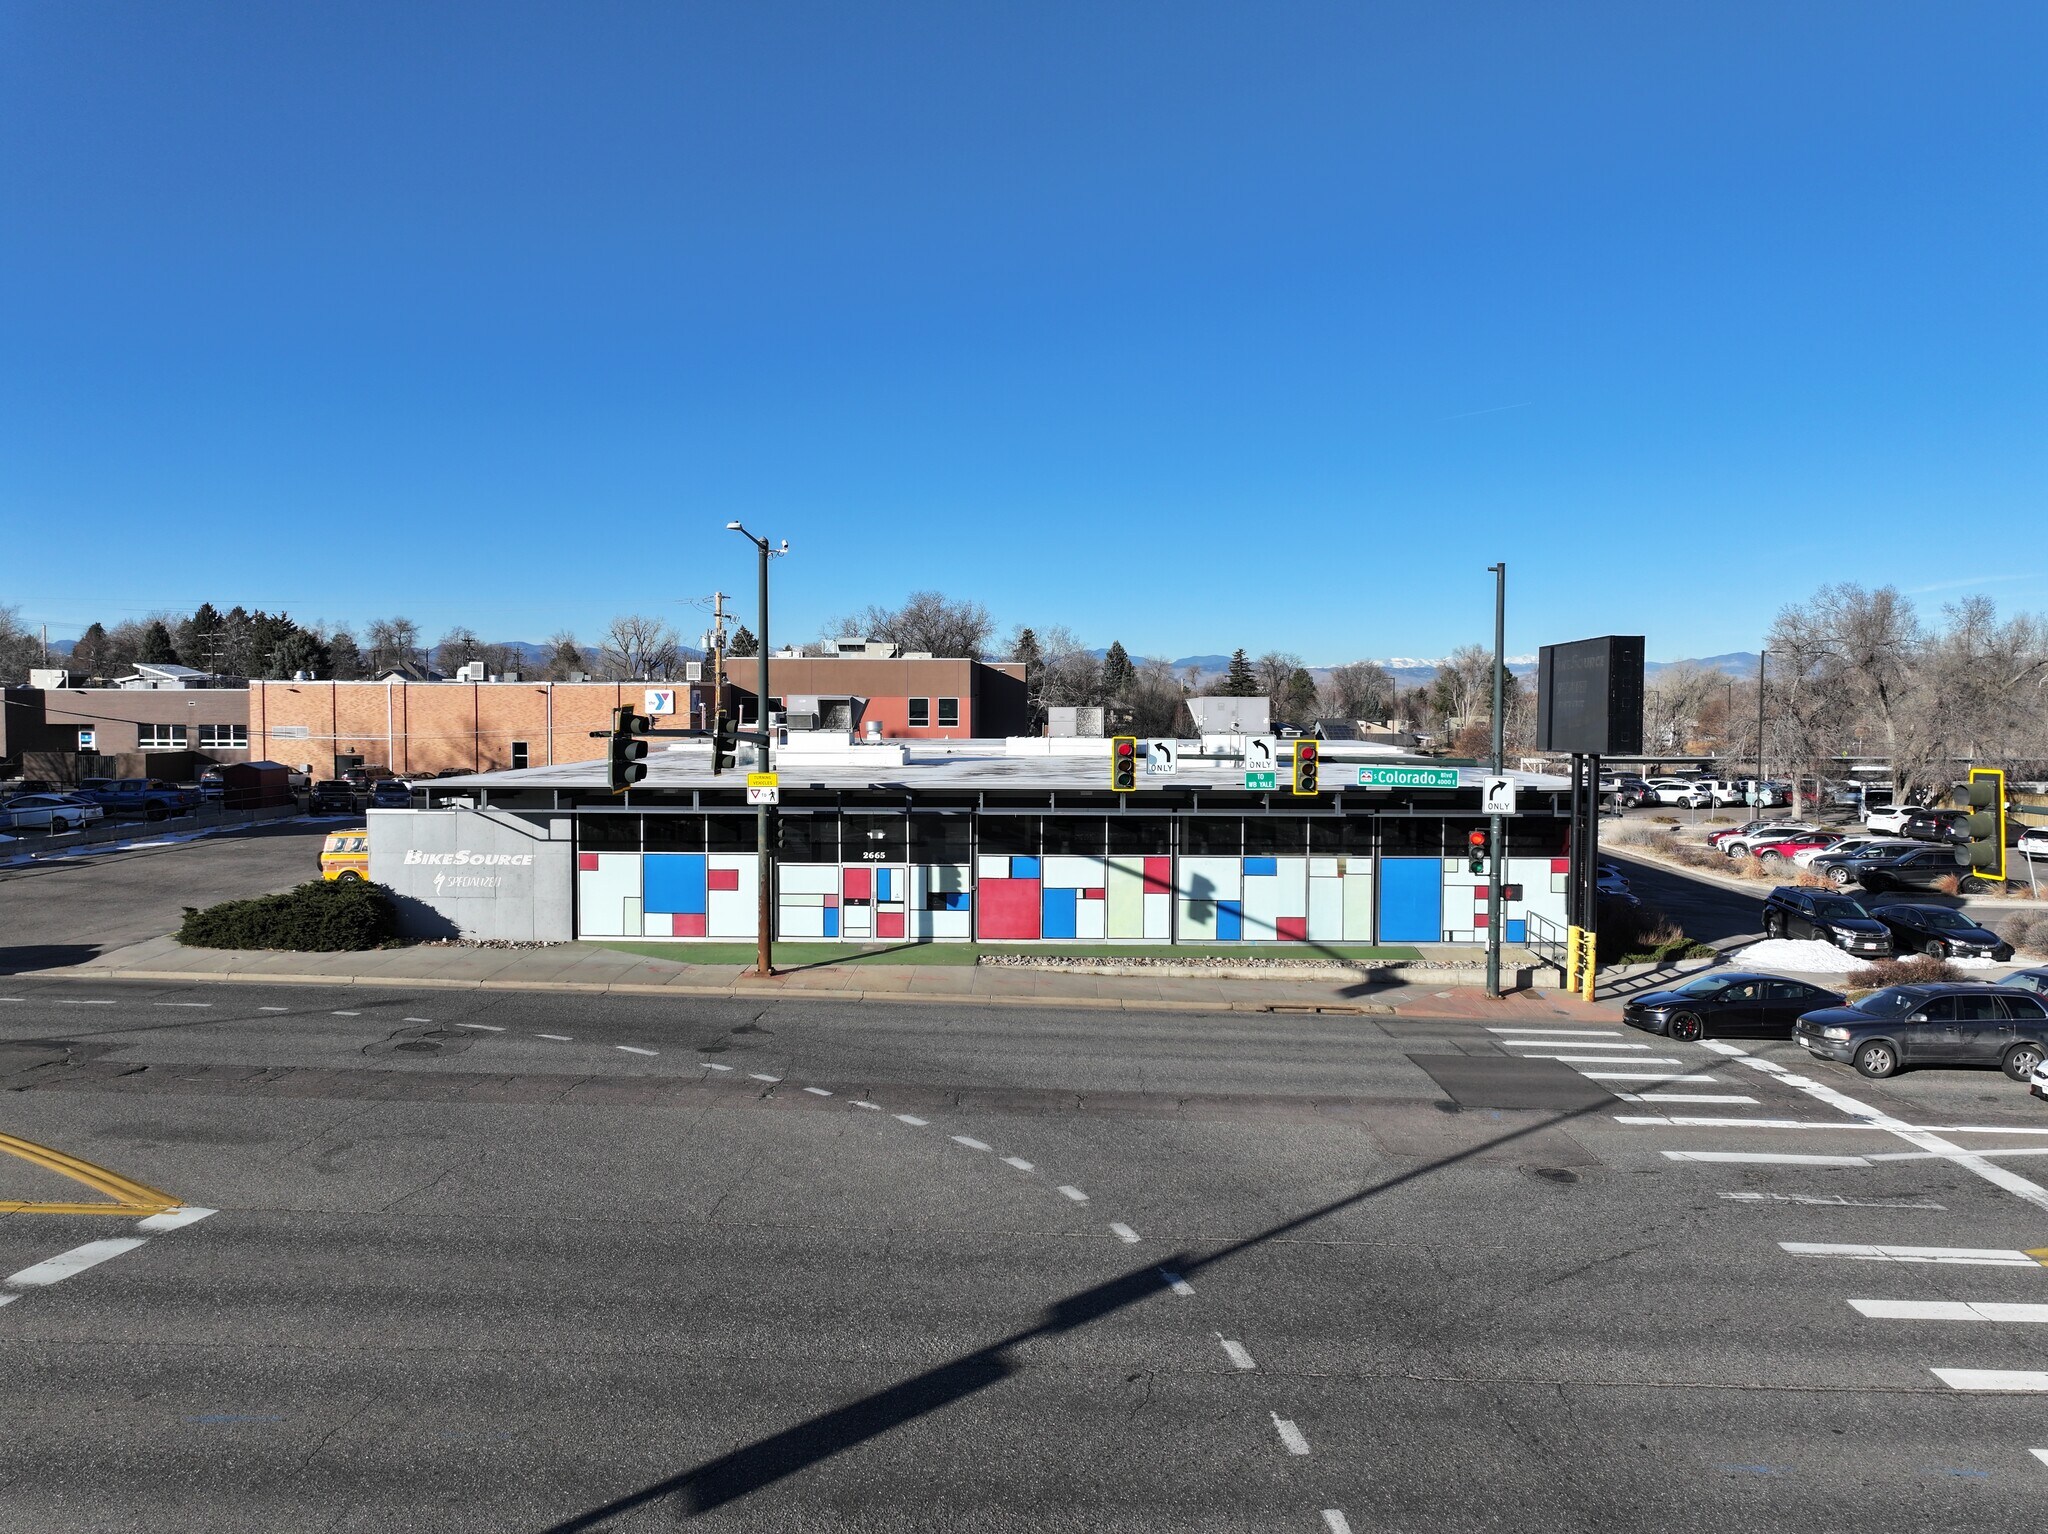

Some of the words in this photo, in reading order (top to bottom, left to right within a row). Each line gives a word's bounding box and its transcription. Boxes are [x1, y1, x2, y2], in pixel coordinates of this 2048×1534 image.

[1150, 764, 1173, 772] ONLY
[1249, 761, 1272, 769] ONLY
[1378, 770, 1436, 785] Colorado
[1487, 802, 1510, 811] ONLY
[862, 851, 886, 860] 2665
